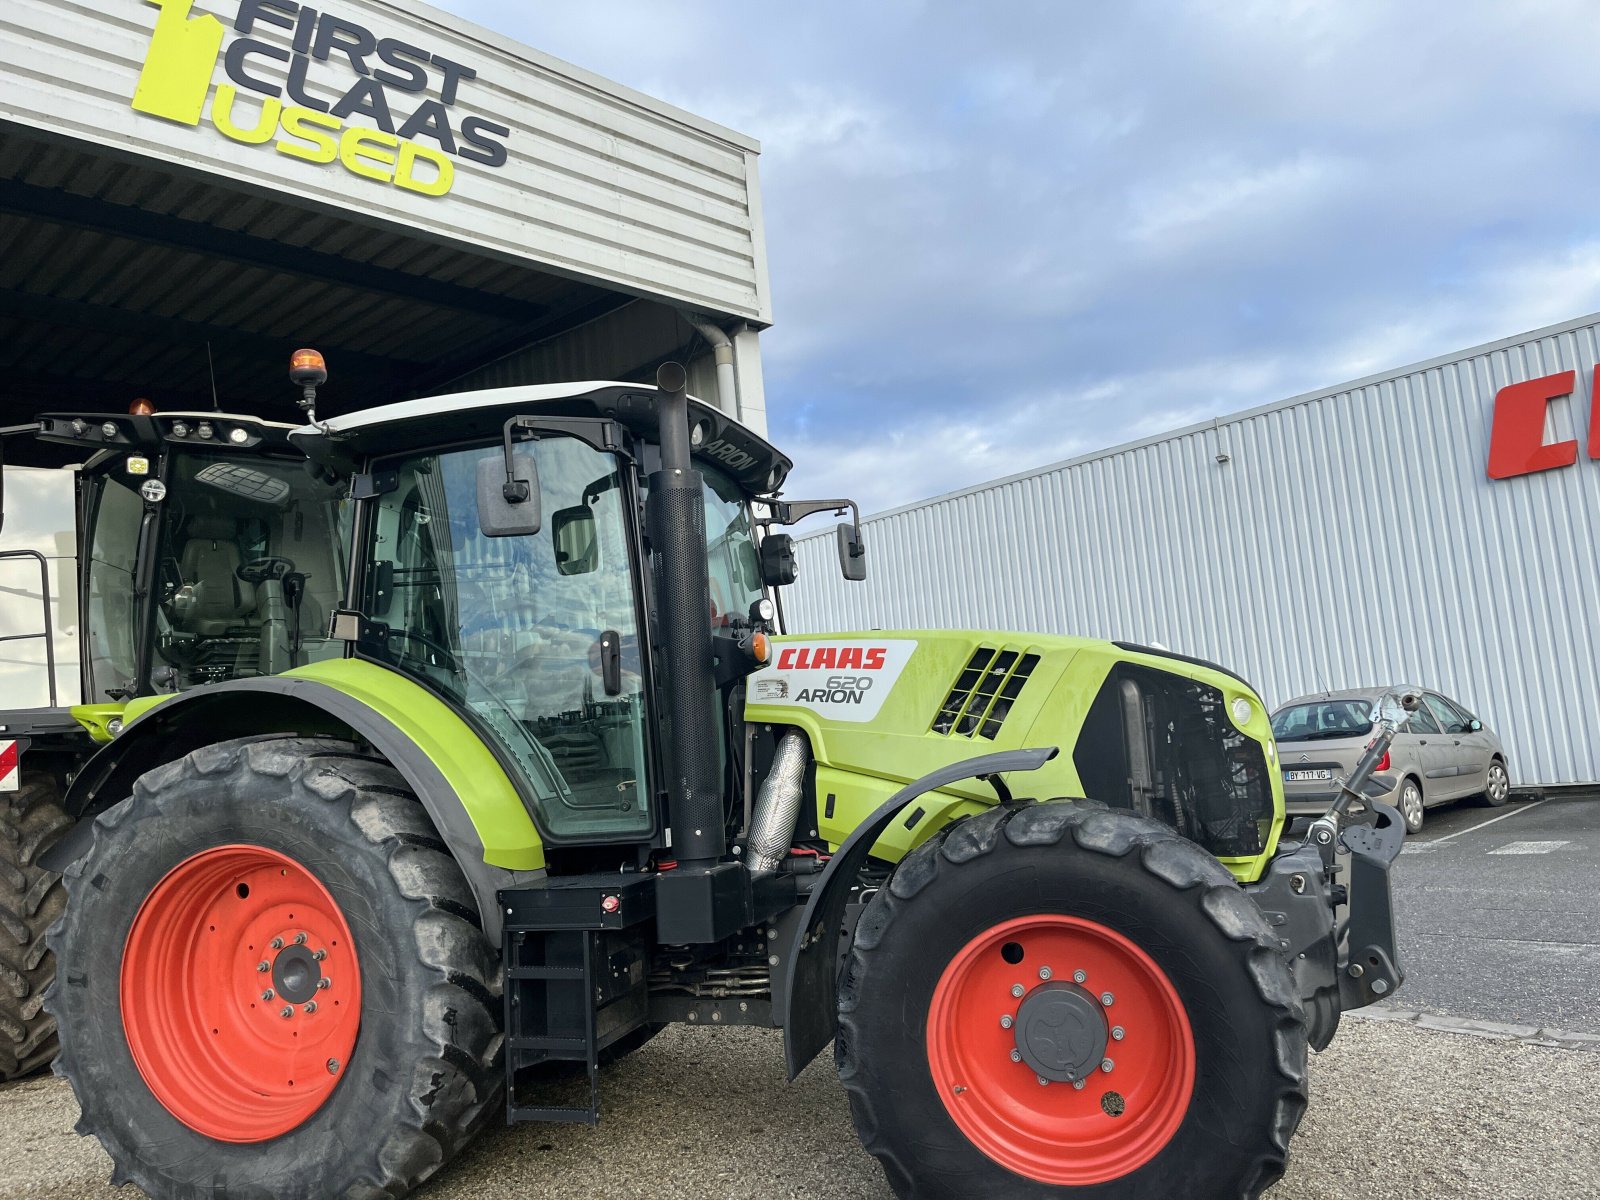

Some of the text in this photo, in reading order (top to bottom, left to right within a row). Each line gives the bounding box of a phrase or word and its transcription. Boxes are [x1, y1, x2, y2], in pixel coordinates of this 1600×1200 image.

[233, 0, 477, 106] FIRST
[224, 37, 510, 167] CLAAS
[211, 83, 455, 197] USED
[703, 438, 759, 471] ARION
[1487, 363, 1600, 480] C
[776, 647, 888, 671] CLAAS
[825, 675, 874, 691] 620
[794, 688, 864, 704] ARION
